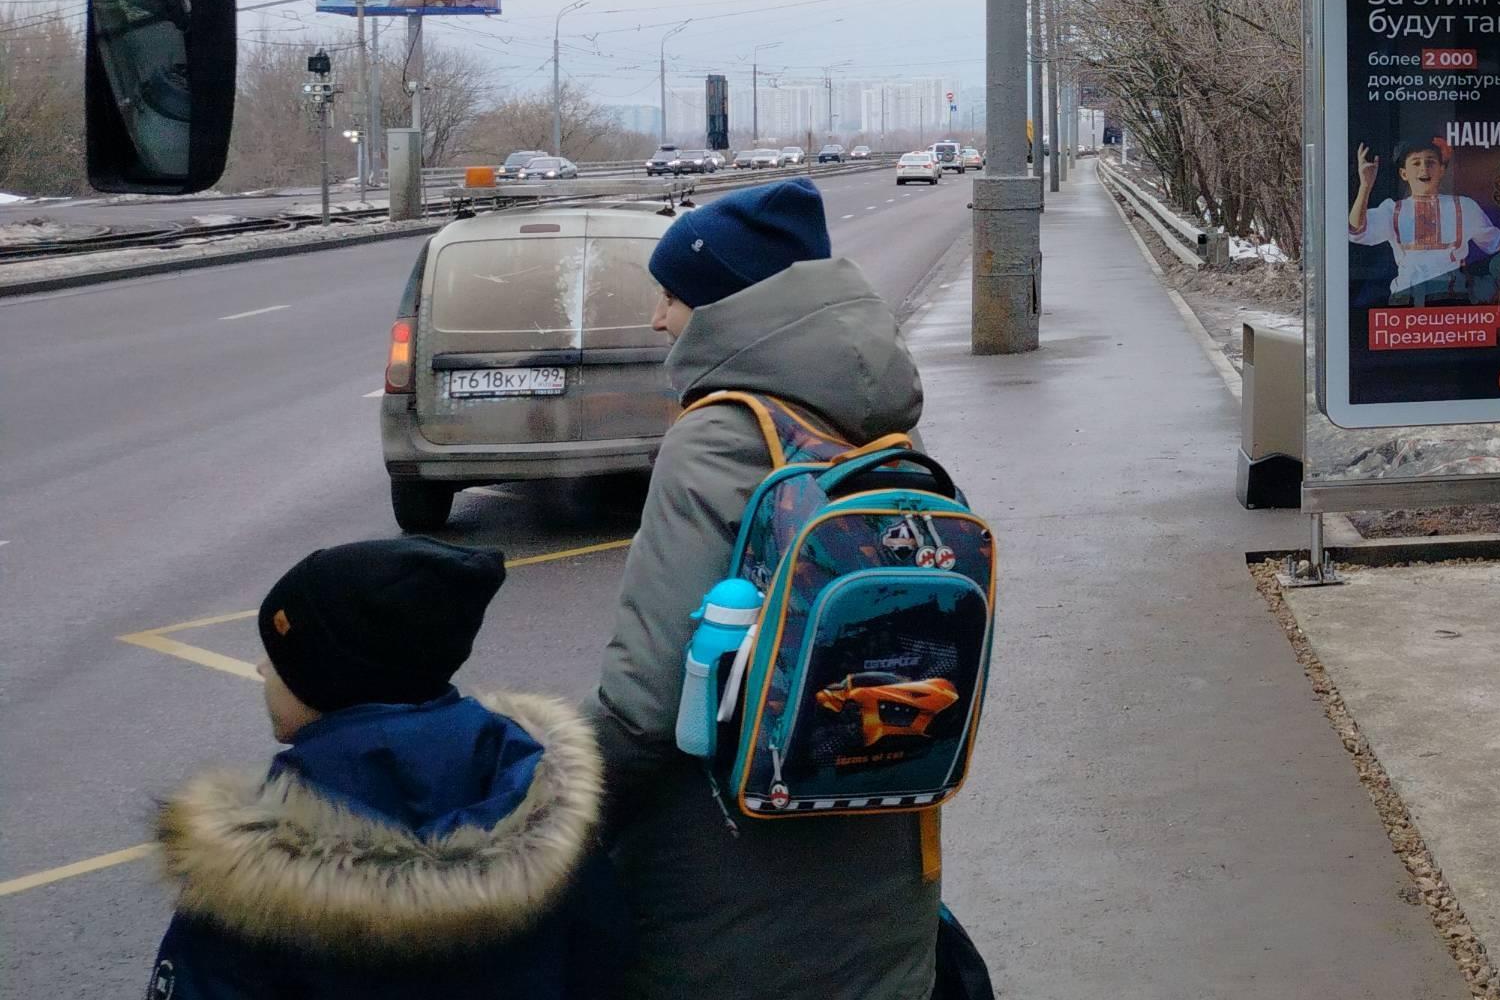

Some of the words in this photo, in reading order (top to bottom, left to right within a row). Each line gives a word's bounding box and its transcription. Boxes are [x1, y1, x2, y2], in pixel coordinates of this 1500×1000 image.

[1368, 8, 1456, 39] будут
[1368, 52, 1421, 66] более
[1367, 74, 1424, 87] домов
[1368, 90, 1380, 101] и
[1384, 88, 1481, 101] обновлено
[1375, 312, 1400, 327] По
[1405, 311, 1495, 329] решению
[1375, 329, 1487, 347] Президента
